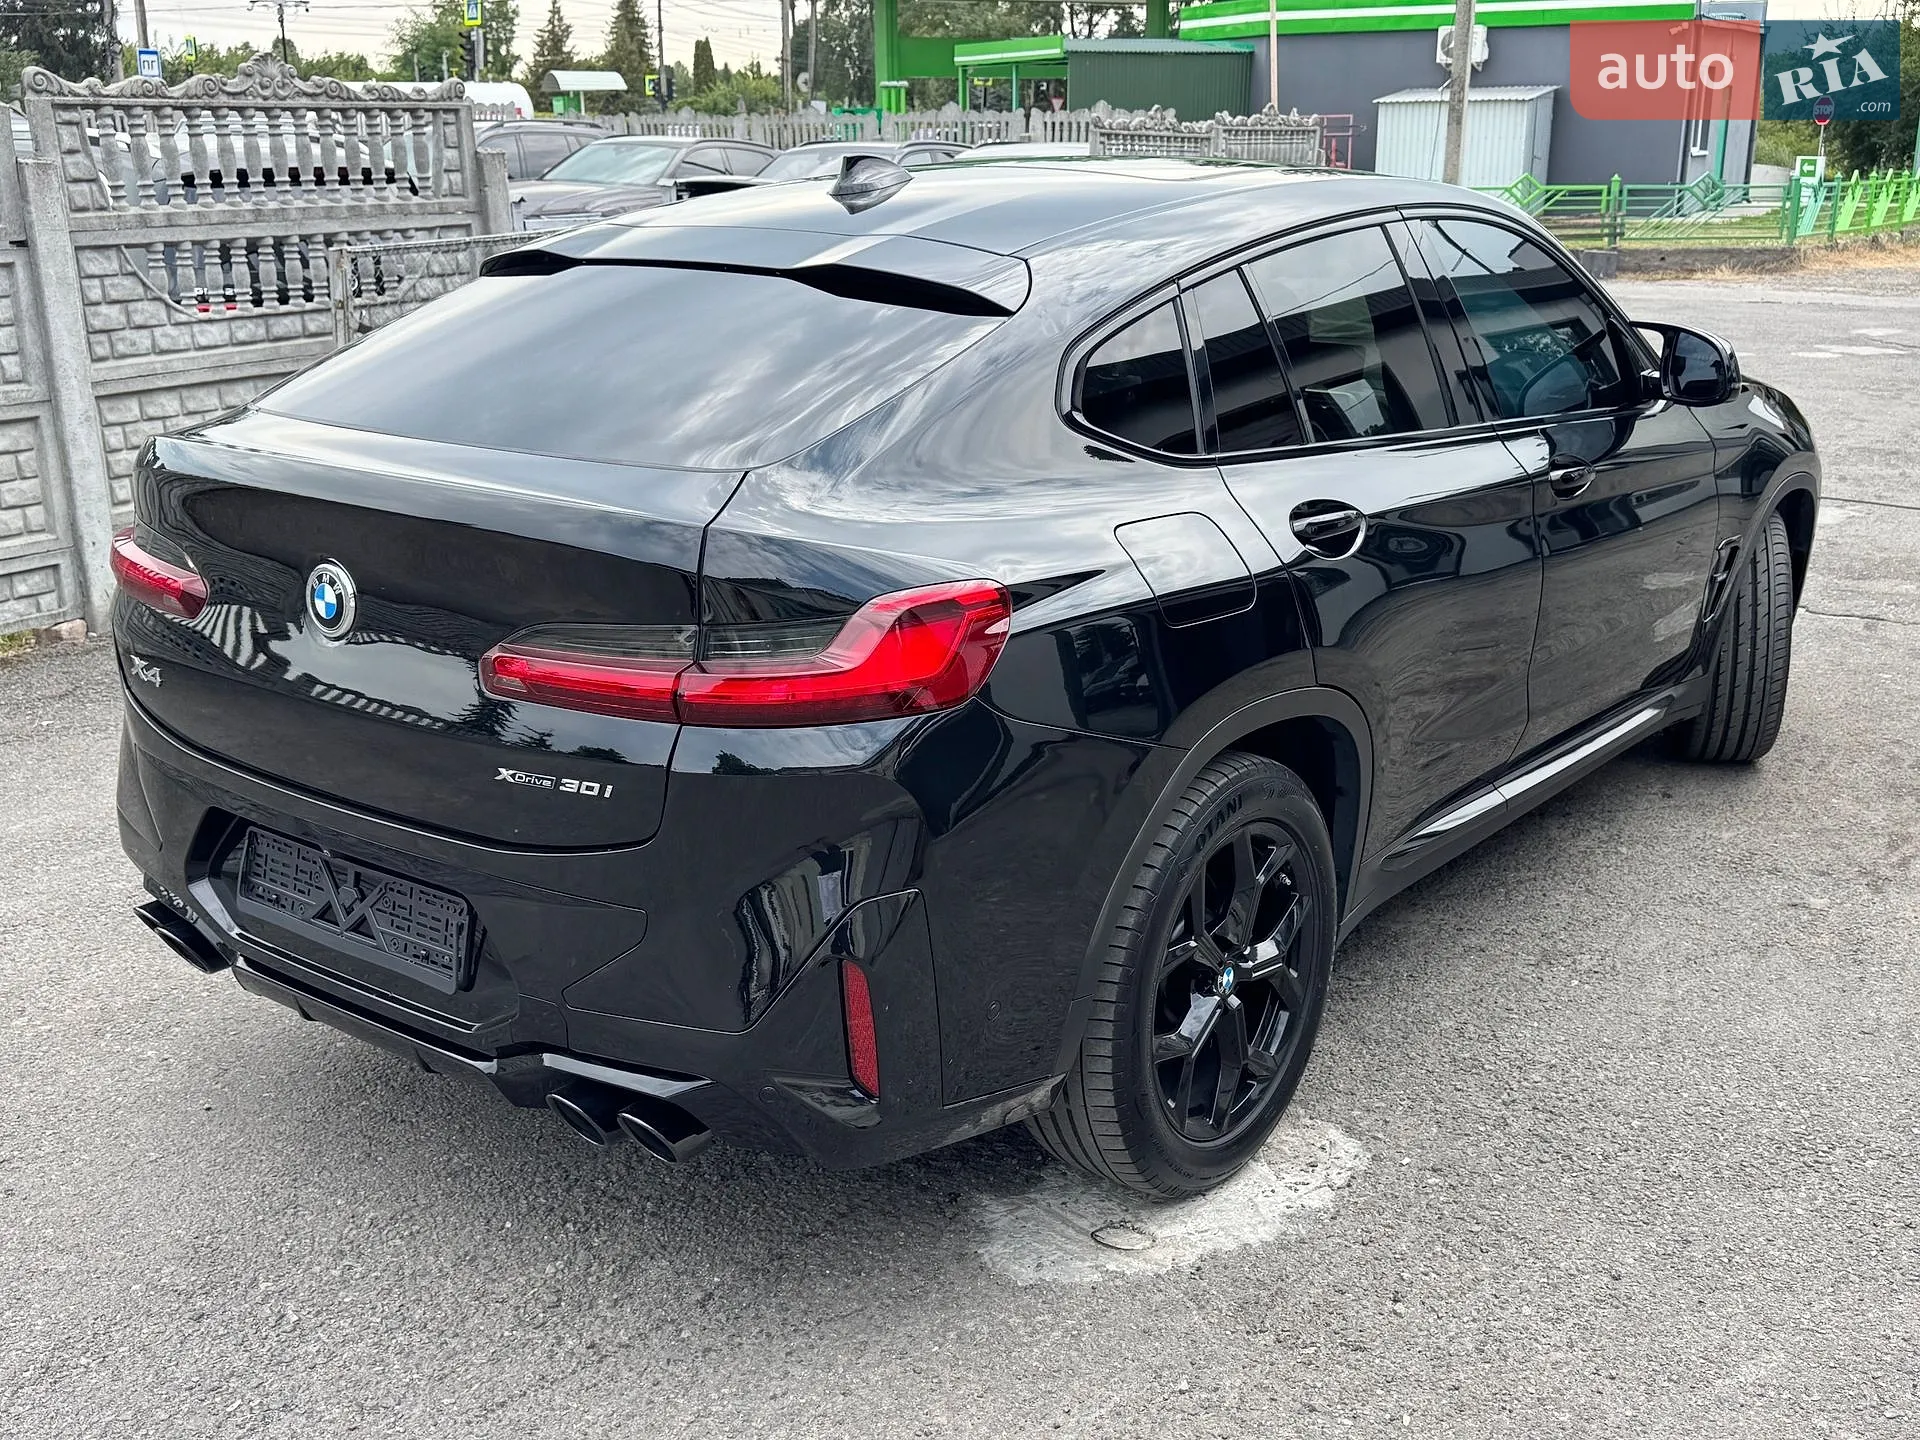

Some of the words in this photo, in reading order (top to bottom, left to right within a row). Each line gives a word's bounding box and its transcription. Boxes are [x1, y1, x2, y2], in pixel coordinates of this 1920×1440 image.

[1814, 104, 1832, 115] STOP
[312, 573, 343, 596] BMW
[129, 654, 162, 688] X4
[1195, 792, 1243, 854] OTANI
